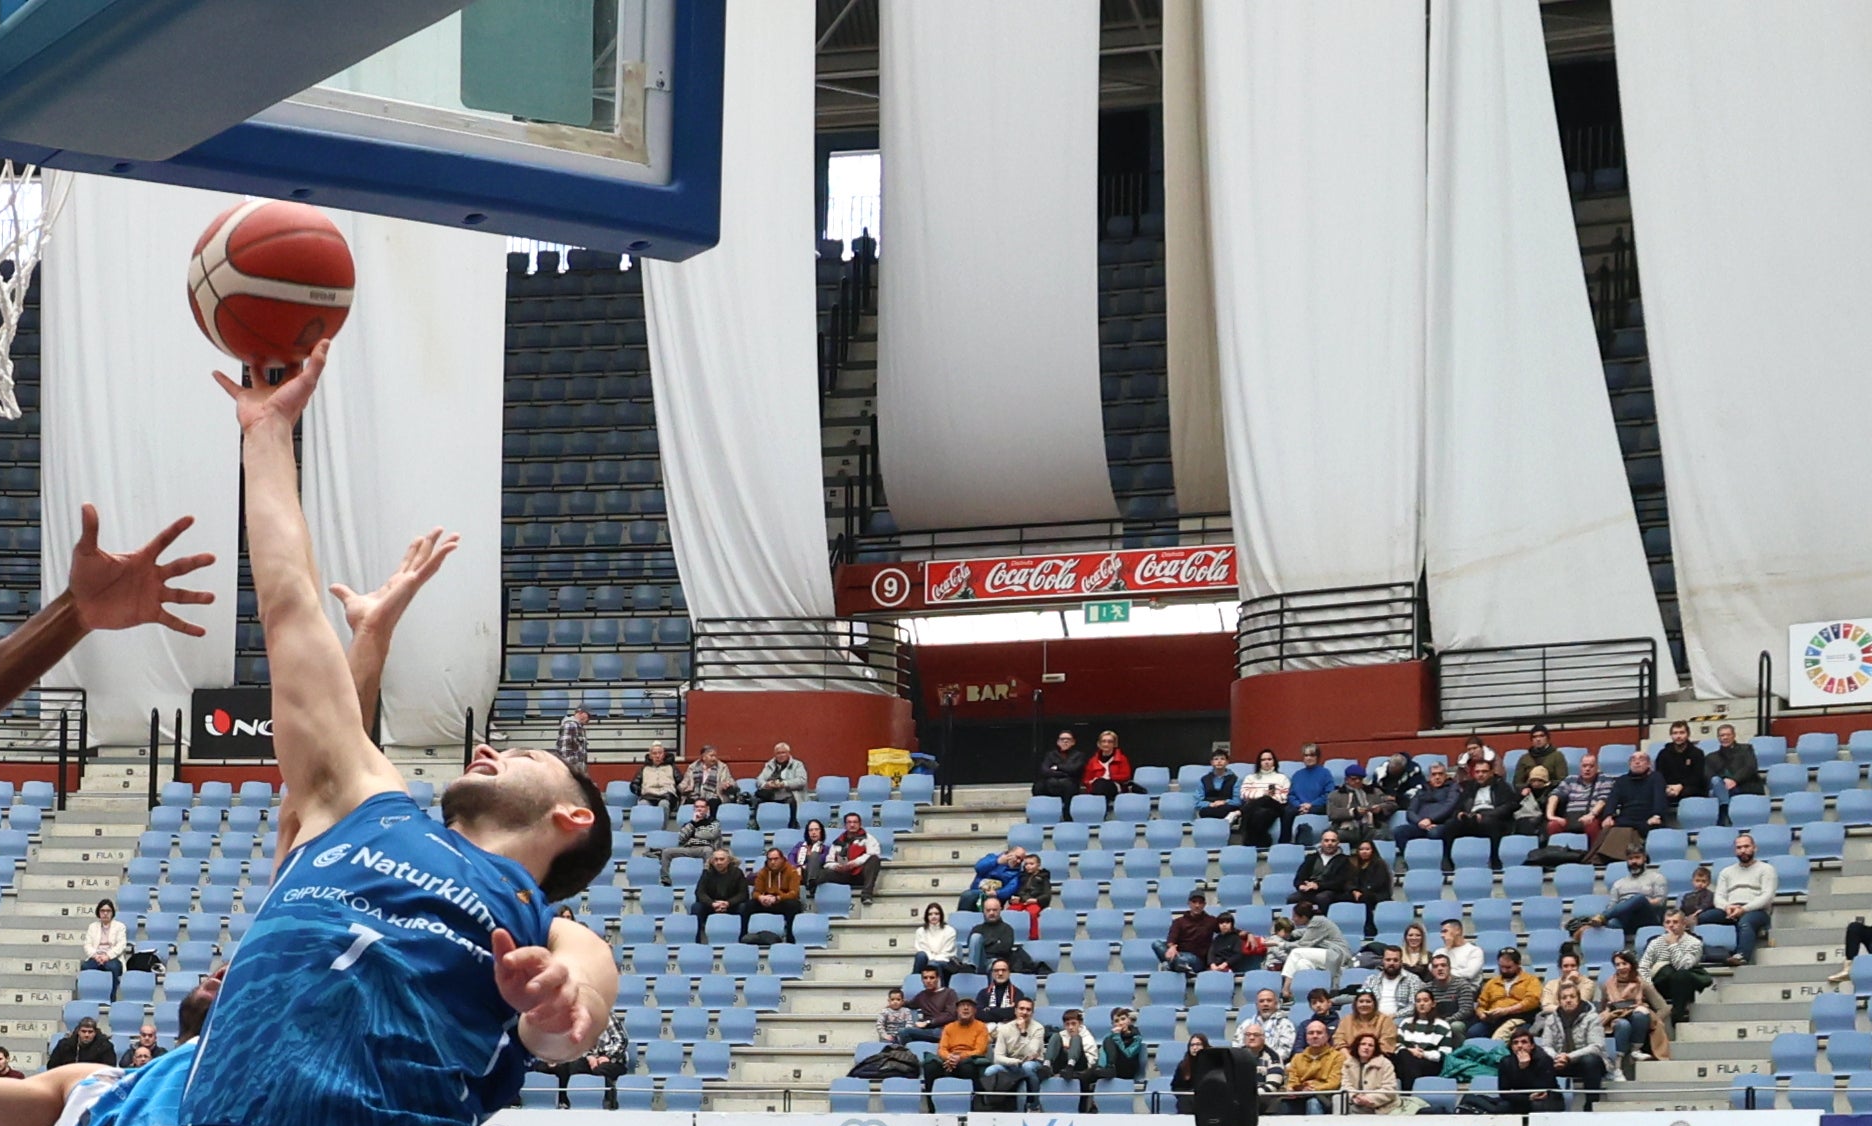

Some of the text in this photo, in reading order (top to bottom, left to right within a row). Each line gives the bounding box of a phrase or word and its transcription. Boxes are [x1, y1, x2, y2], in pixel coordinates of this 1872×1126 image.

[984, 558, 1080, 594] Coca-Cola
[1133, 549, 1234, 586] Coca-Cola
[883, 578, 899, 598] 9
[966, 684, 1010, 702] BAR
[283, 886, 382, 921] GIPUZKOA
[350, 846, 497, 933] Naturklim
[330, 922, 385, 971] 7
[1716, 1064, 1741, 1074] FILA
